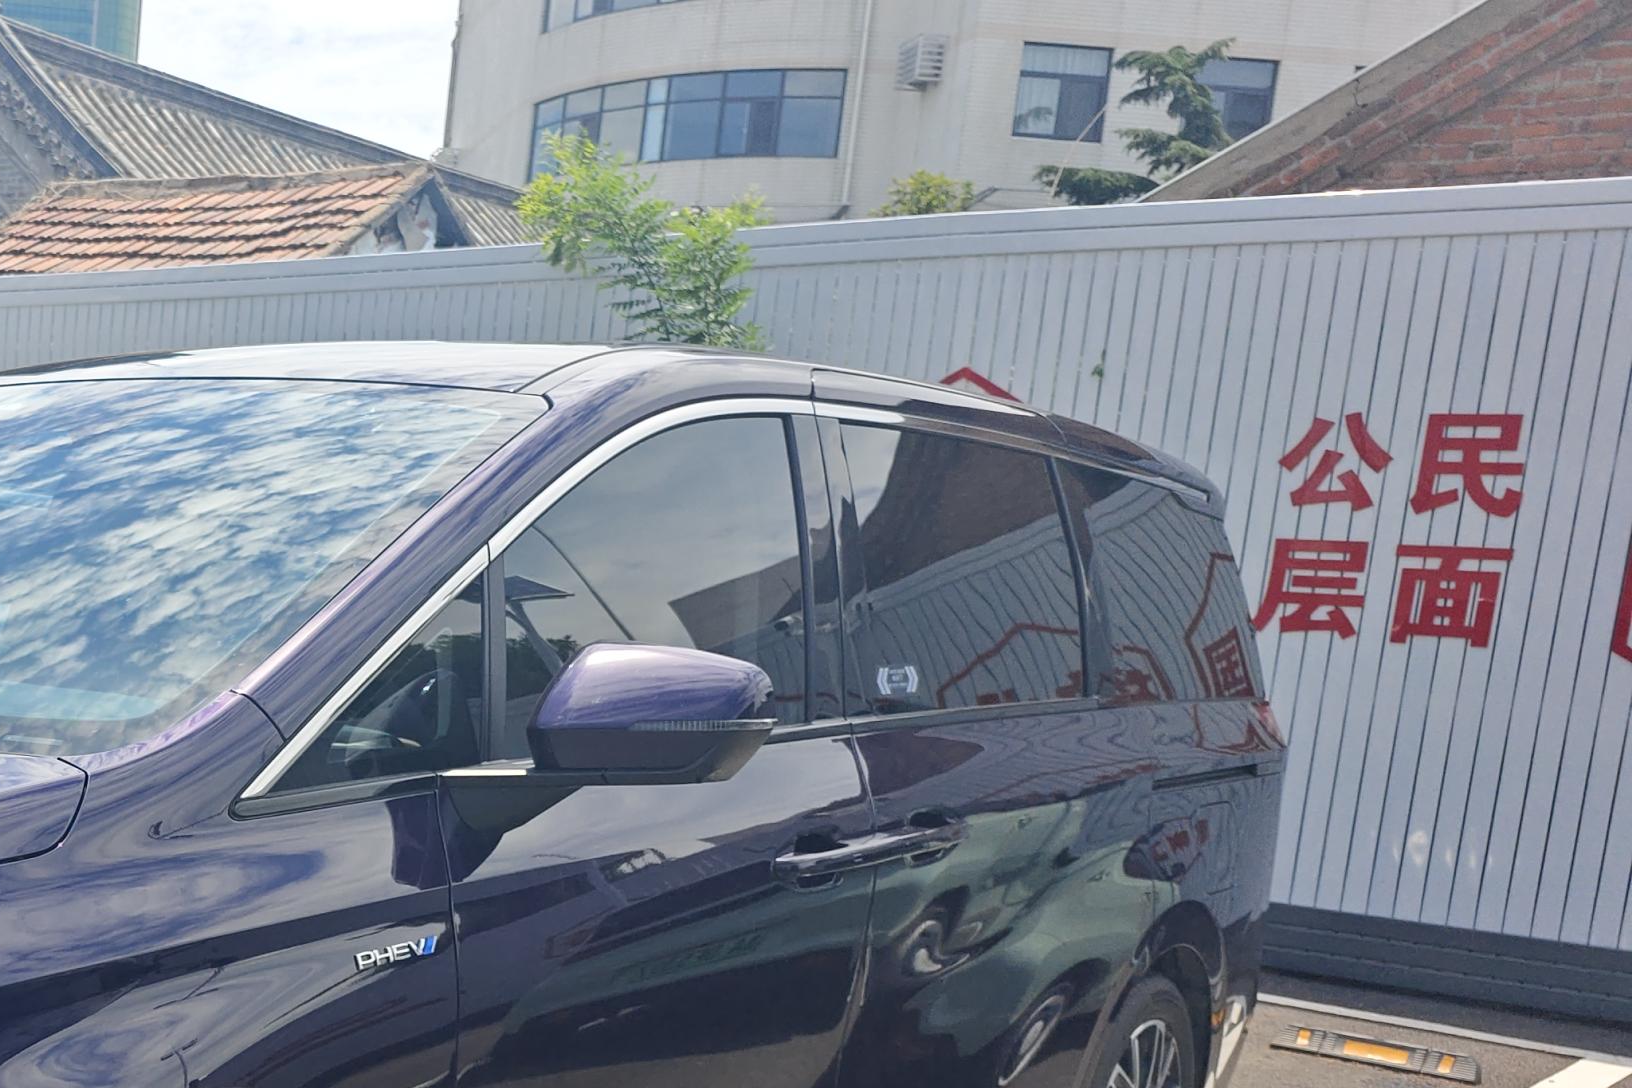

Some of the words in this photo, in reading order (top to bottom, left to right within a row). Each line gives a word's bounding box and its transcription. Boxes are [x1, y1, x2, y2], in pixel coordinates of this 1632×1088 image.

[1279, 411, 1525, 519] 公民
[1251, 538, 1515, 649] 层面
[354, 935, 438, 971] PHEV
